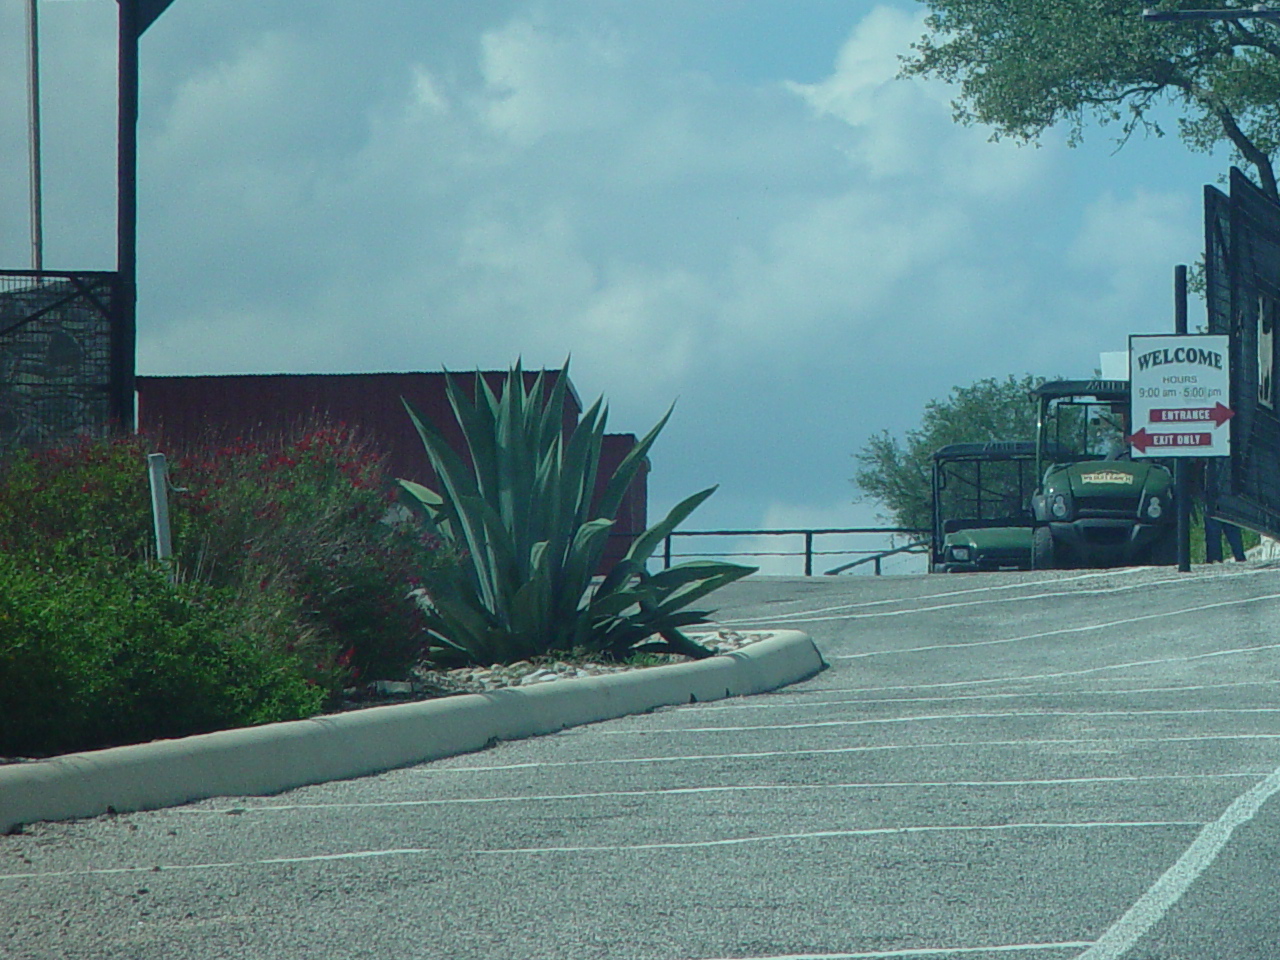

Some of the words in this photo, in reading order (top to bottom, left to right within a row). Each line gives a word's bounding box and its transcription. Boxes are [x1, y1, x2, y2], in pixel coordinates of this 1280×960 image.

[1138, 347, 1223, 371] WELCOME
[1162, 375, 1198, 384] HOURS
[1139, 387, 1160, 398] 9:00
[1183, 386, 1205, 398] 5:00
[1161, 409, 1210, 420] ENTRANCE
[1153, 435, 1174, 445] EXIT
[1177, 434, 1201, 445] ONLY
